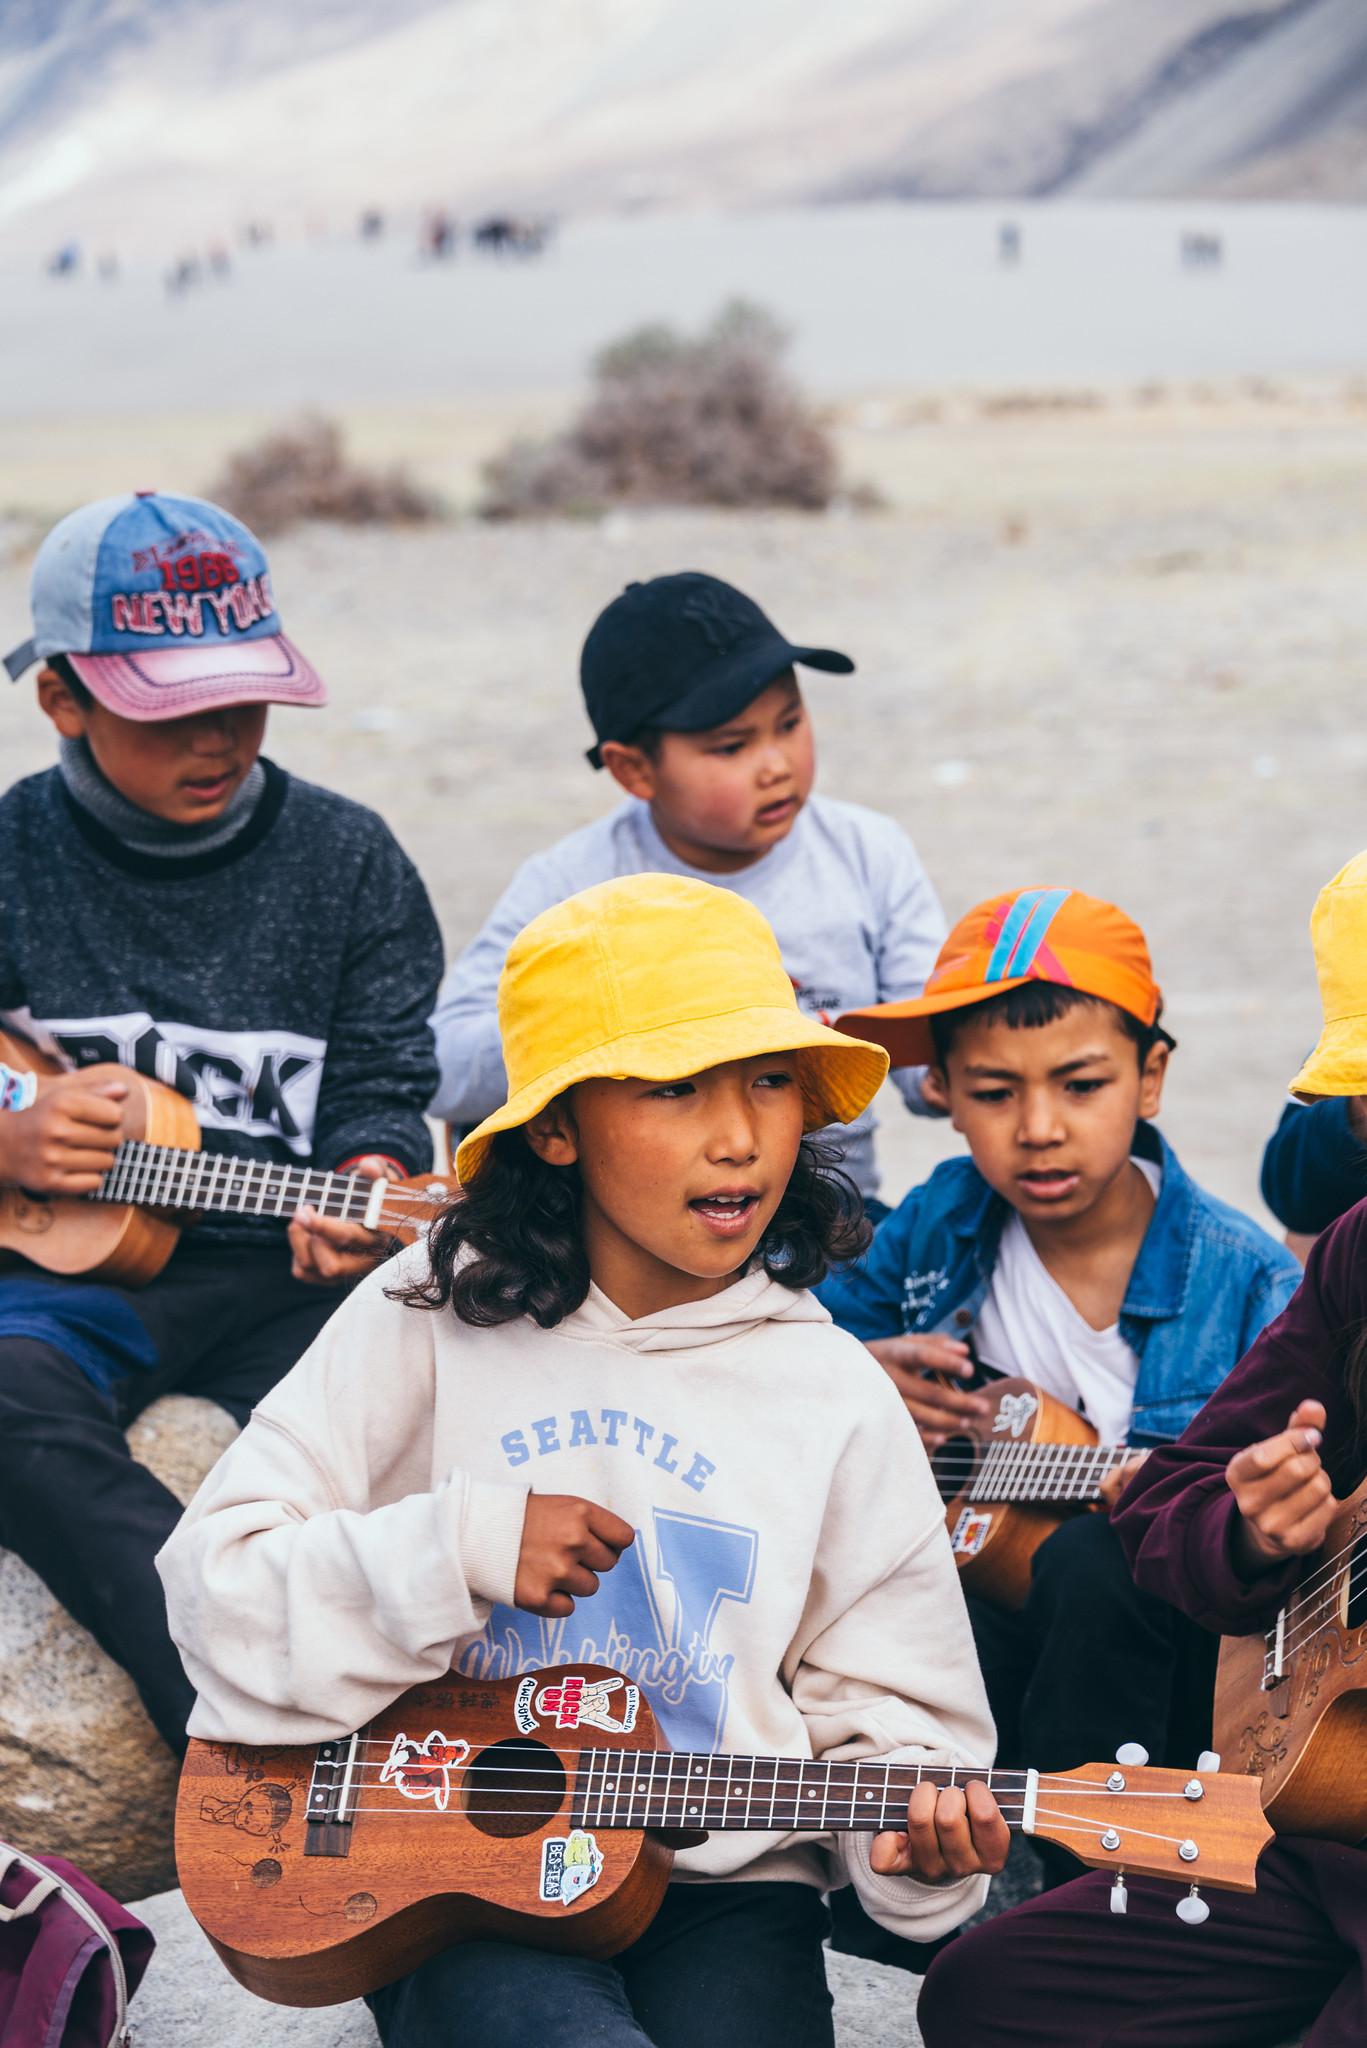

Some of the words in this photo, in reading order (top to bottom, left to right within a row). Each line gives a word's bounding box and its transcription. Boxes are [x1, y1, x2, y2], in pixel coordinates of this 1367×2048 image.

[112, 590, 203, 637] NEW
[500, 1408, 717, 1493] SEATTLE
[517, 1679, 536, 1732] AWESOME
[541, 1688, 563, 1712] ON
[560, 1679, 584, 1726] ROCK
[626, 1704, 636, 1724] Need
[628, 1688, 636, 1699] All
